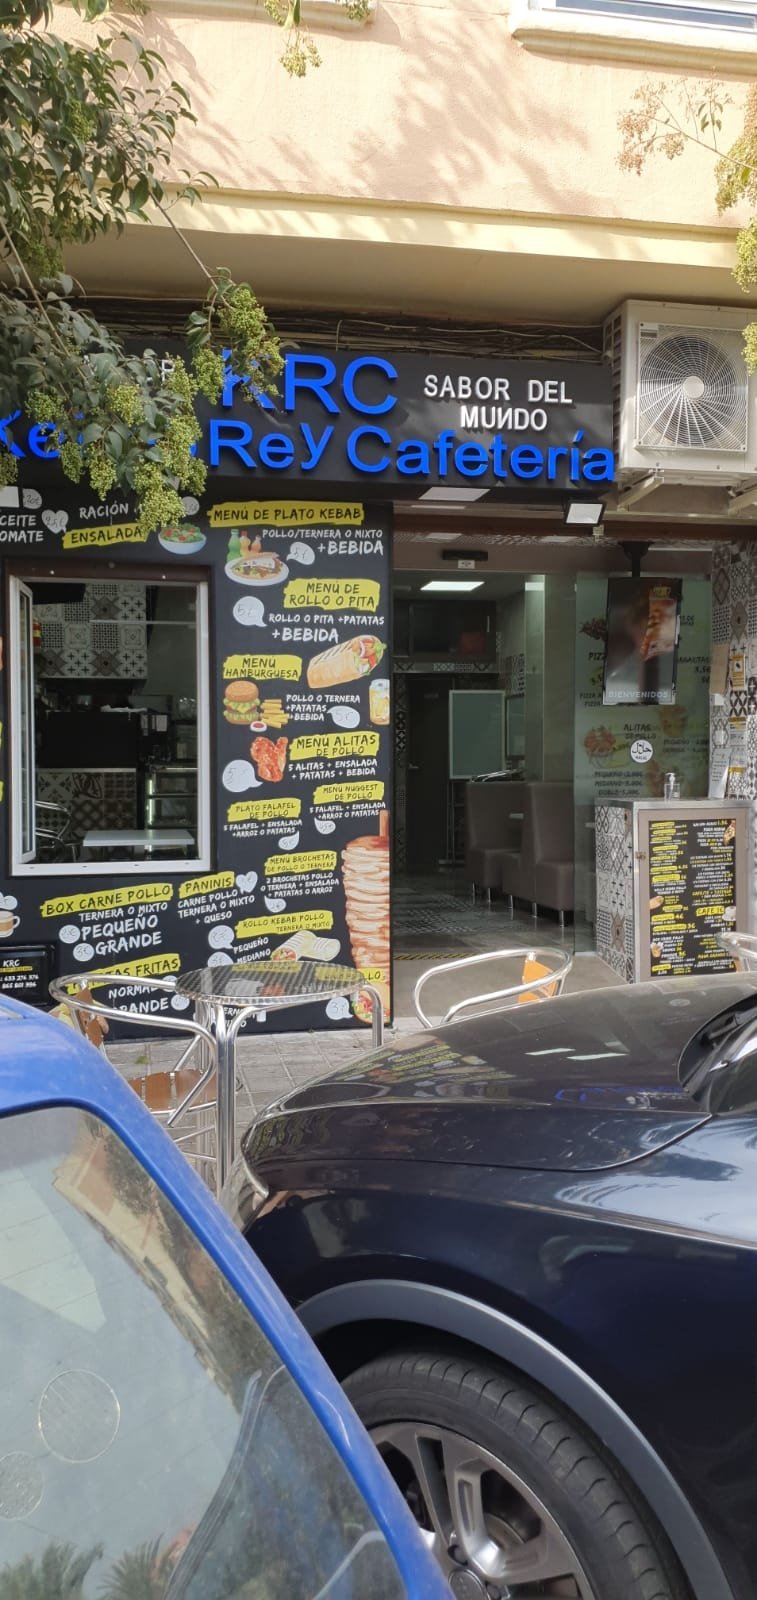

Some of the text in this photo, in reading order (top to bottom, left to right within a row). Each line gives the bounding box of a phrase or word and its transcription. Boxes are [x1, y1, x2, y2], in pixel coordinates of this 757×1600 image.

[423, 374, 573, 405] SABOR DEL
[209, 419, 334, 471] Rey
[347, 426, 615, 482] Cafetería
[79, 501, 129, 520] RACIÓN
[214, 507, 362, 521] MENÚ DE PLATO KEBAB
[0, 514, 37, 527] CEITE
[0, 530, 44, 544] OMATE
[71, 526, 143, 544] ENSALADA
[262, 529, 383, 539] POLLO/TERNERA O MIXTO
[306, 580, 360, 594] MENÚ DE
[289, 595, 375, 608] ROLLO O PITA
[268, 613, 301, 624] ROLLO
[303, 614, 311, 623] O
[313, 613, 335, 625] PITA
[225, 669, 299, 679] HAMBURGUESA
[286, 694, 361, 704] POLLO O TERNERA
[608, 690, 669, 699] BIENVENIDOS
[623, 723, 651, 732] ALITAS
[334, 734, 377, 747] ALITAS
[316, 747, 365, 757] DE POLLO
[295, 761, 324, 771] ALITAS
[335, 758, 378, 769] ENSALADA
[299, 770, 336, 781] PATATAS
[346, 766, 377, 777] BEBIDA
[334, 791, 373, 801] DE POLLO
[235, 801, 296, 813] PLATO FALAFEL
[315, 804, 344, 813] FALAFEL
[352, 801, 386, 810] ENSALADA
[351, 809, 380, 818] PATATAS
[250, 809, 289, 819] DE POLLO
[229, 822, 259, 832] FALAFEL
[267, 819, 303, 828] ENSALADA
[266, 827, 296, 836] PATATAS
[293, 853, 335, 863] BROCHETAS
[185, 876, 232, 893] PANINIS
[272, 874, 311, 884] BROCHETAS
[312, 872, 334, 880] POLLO
[268, 882, 297, 892] TERNERA
[305, 878, 340, 887] ENSALADA
[274, 889, 303, 898] PATATAS
[311, 886, 333, 894] ARROZ
[46, 884, 172, 915] BOX CARNE POLLO
[177, 889, 238, 909] CARNE POLLO
[78, 902, 168, 923] TERNERA O MIXTO
[178, 904, 218, 919] TERNERA
[220, 901, 227, 910] O
[229, 895, 255, 908] MIXTO
[203, 911, 233, 924] QUESO
[299, 913, 325, 922] POLLO
[80, 912, 159, 941] PEQUEÑO
[95, 931, 163, 956] GRANDE
[233, 936, 270, 954] PEQUEÑO
[236, 949, 272, 963] MEDIANO
[3, 959, 21, 968] KRC
[135, 958, 179, 977] FRITAS
[112, 998, 169, 1013] RANDE
